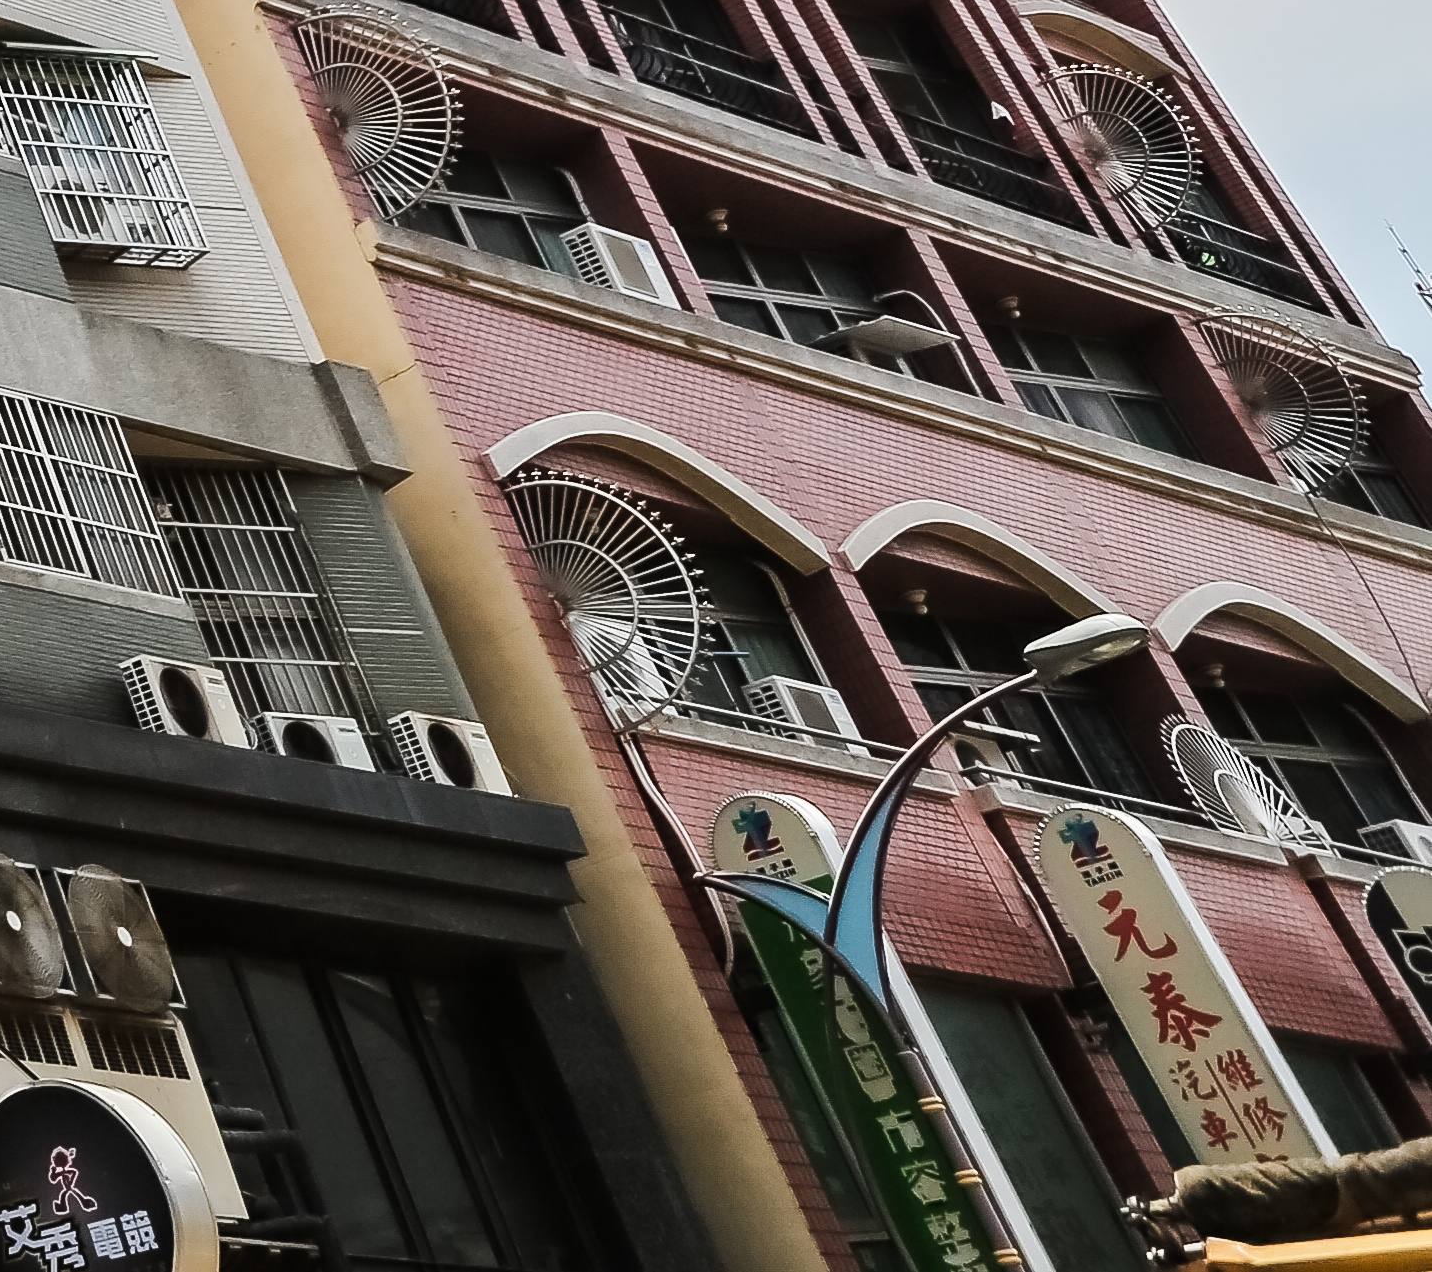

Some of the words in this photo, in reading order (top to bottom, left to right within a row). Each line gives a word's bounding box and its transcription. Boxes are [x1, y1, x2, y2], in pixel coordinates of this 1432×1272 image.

[1096, 889, 1223, 1053] 元泰
[1168, 1059, 1239, 1152] 汽車
[1216, 1048, 1288, 1143] 維修
